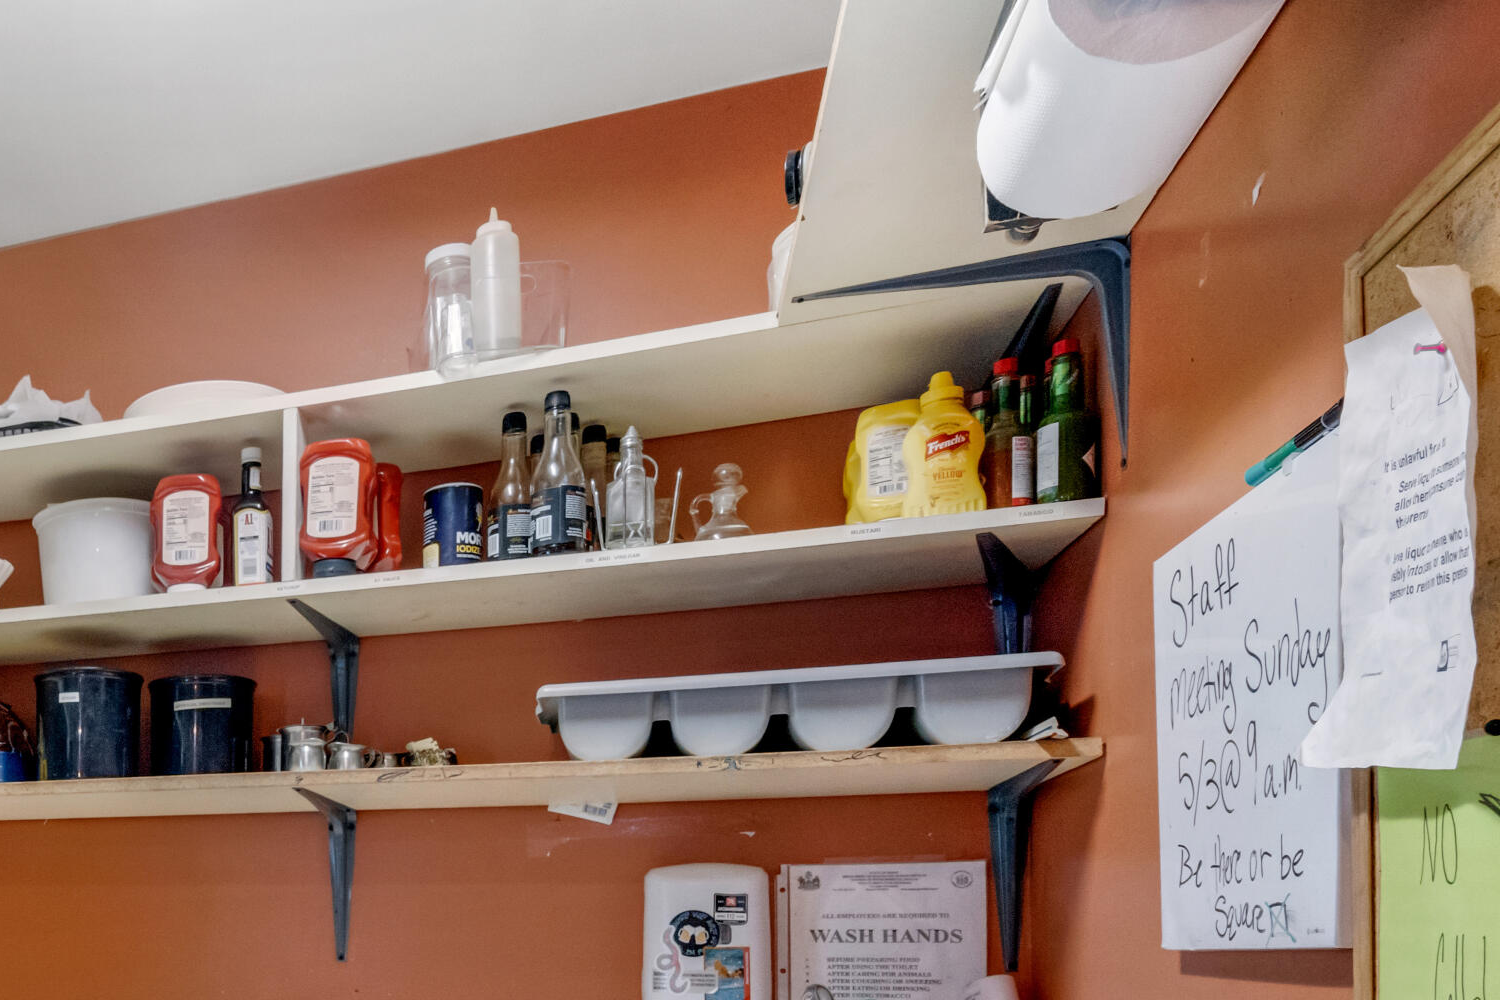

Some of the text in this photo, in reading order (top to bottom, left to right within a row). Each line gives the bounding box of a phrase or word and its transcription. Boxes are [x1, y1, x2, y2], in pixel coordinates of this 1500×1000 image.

[927, 434, 967, 456] French's
[456, 531, 481, 545] MOR
[456, 545, 480, 554] IODIZ
[1169, 537, 1239, 648] Staff
[1170, 598, 1331, 734] meeting Sunday
[1177, 832, 1304, 894] Be there or be
[1419, 803, 1458, 885] NO
[809, 928, 964, 943] WASH HANDS
[1214, 895, 1266, 942] Square
